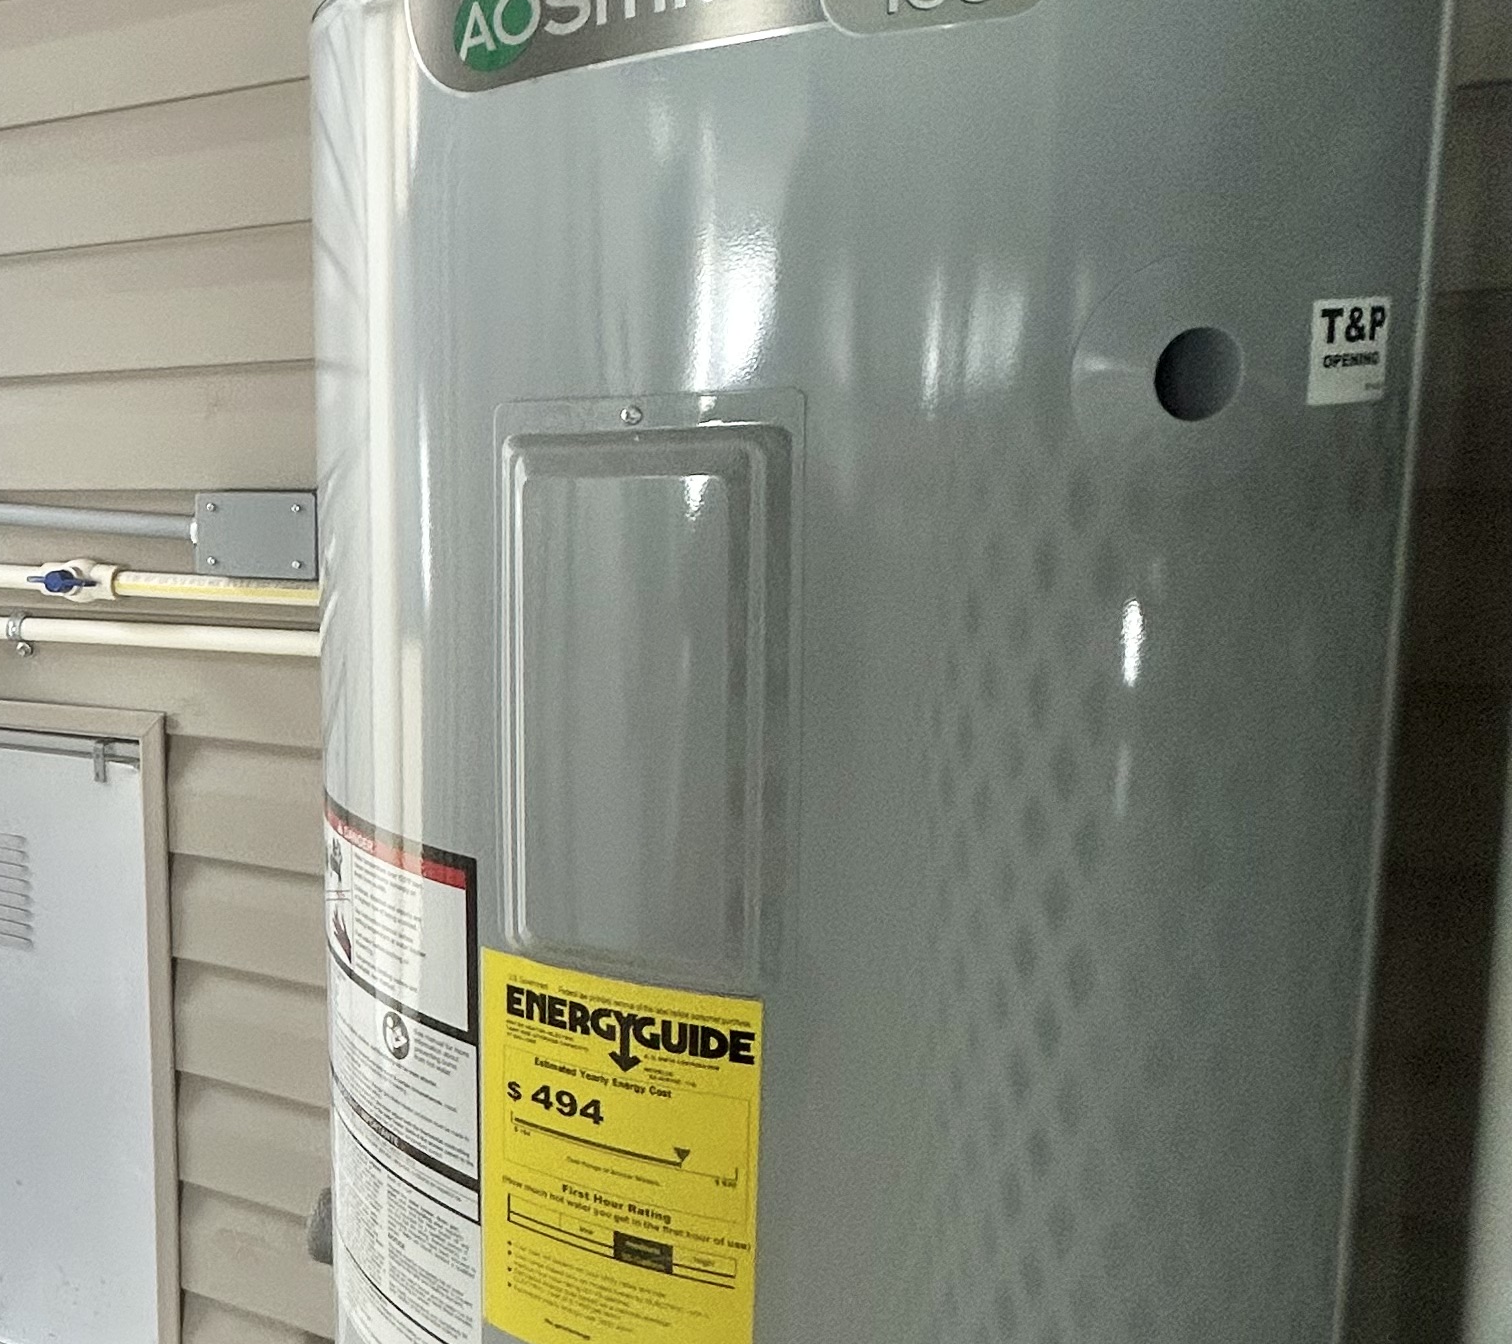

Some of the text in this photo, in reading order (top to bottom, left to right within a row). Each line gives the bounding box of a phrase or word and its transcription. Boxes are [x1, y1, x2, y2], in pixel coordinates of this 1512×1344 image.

[1320, 304, 1386, 344] T&P
[1323, 351, 1380, 368] OPENING
[534, 1056, 577, 1077] Estimated
[580, 1069, 610, 1086] Yearly
[612, 1077, 647, 1095] Energy
[648, 1085, 672, 1099] Cost
[531, 1084, 604, 1126] 494
[561, 1183, 671, 1225] First Hour Rating
[593, 1207, 613, 1219] you
[643, 1220, 660, 1231] the
[713, 1236, 726, 1246] of
